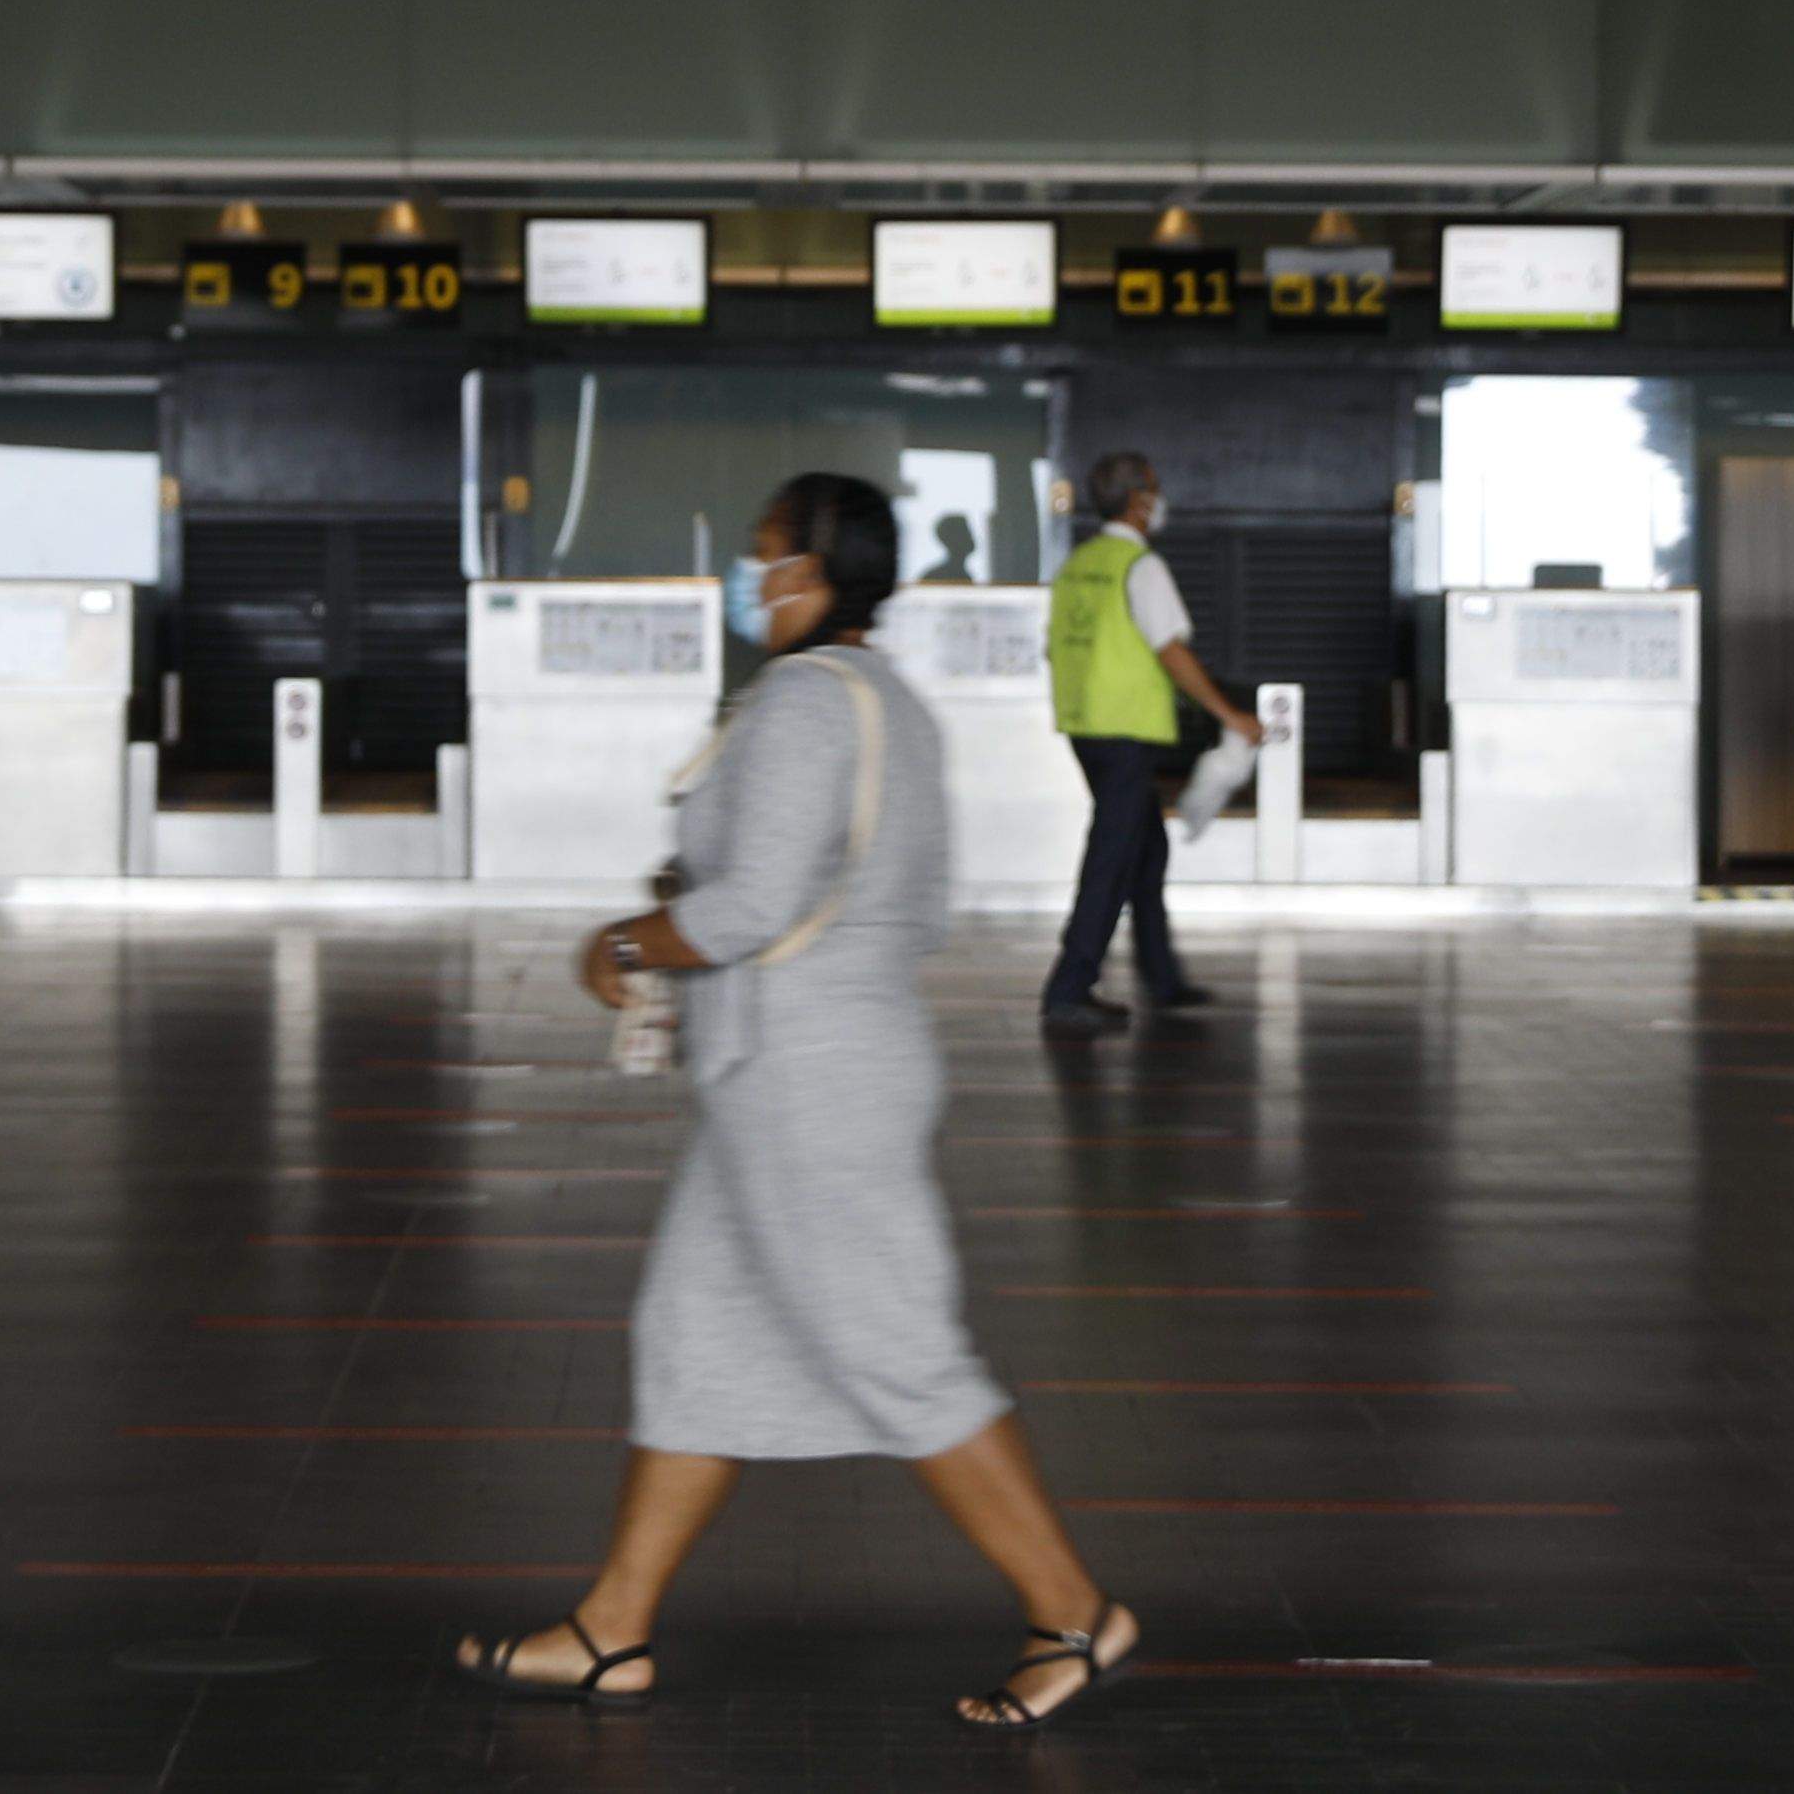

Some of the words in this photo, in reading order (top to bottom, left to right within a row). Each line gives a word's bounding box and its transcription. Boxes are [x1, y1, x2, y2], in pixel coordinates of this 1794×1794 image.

[267, 262, 304, 310] 9
[395, 263, 460, 311] 10
[1172, 269, 1234, 316] 11
[1326, 272, 1386, 316] 12
